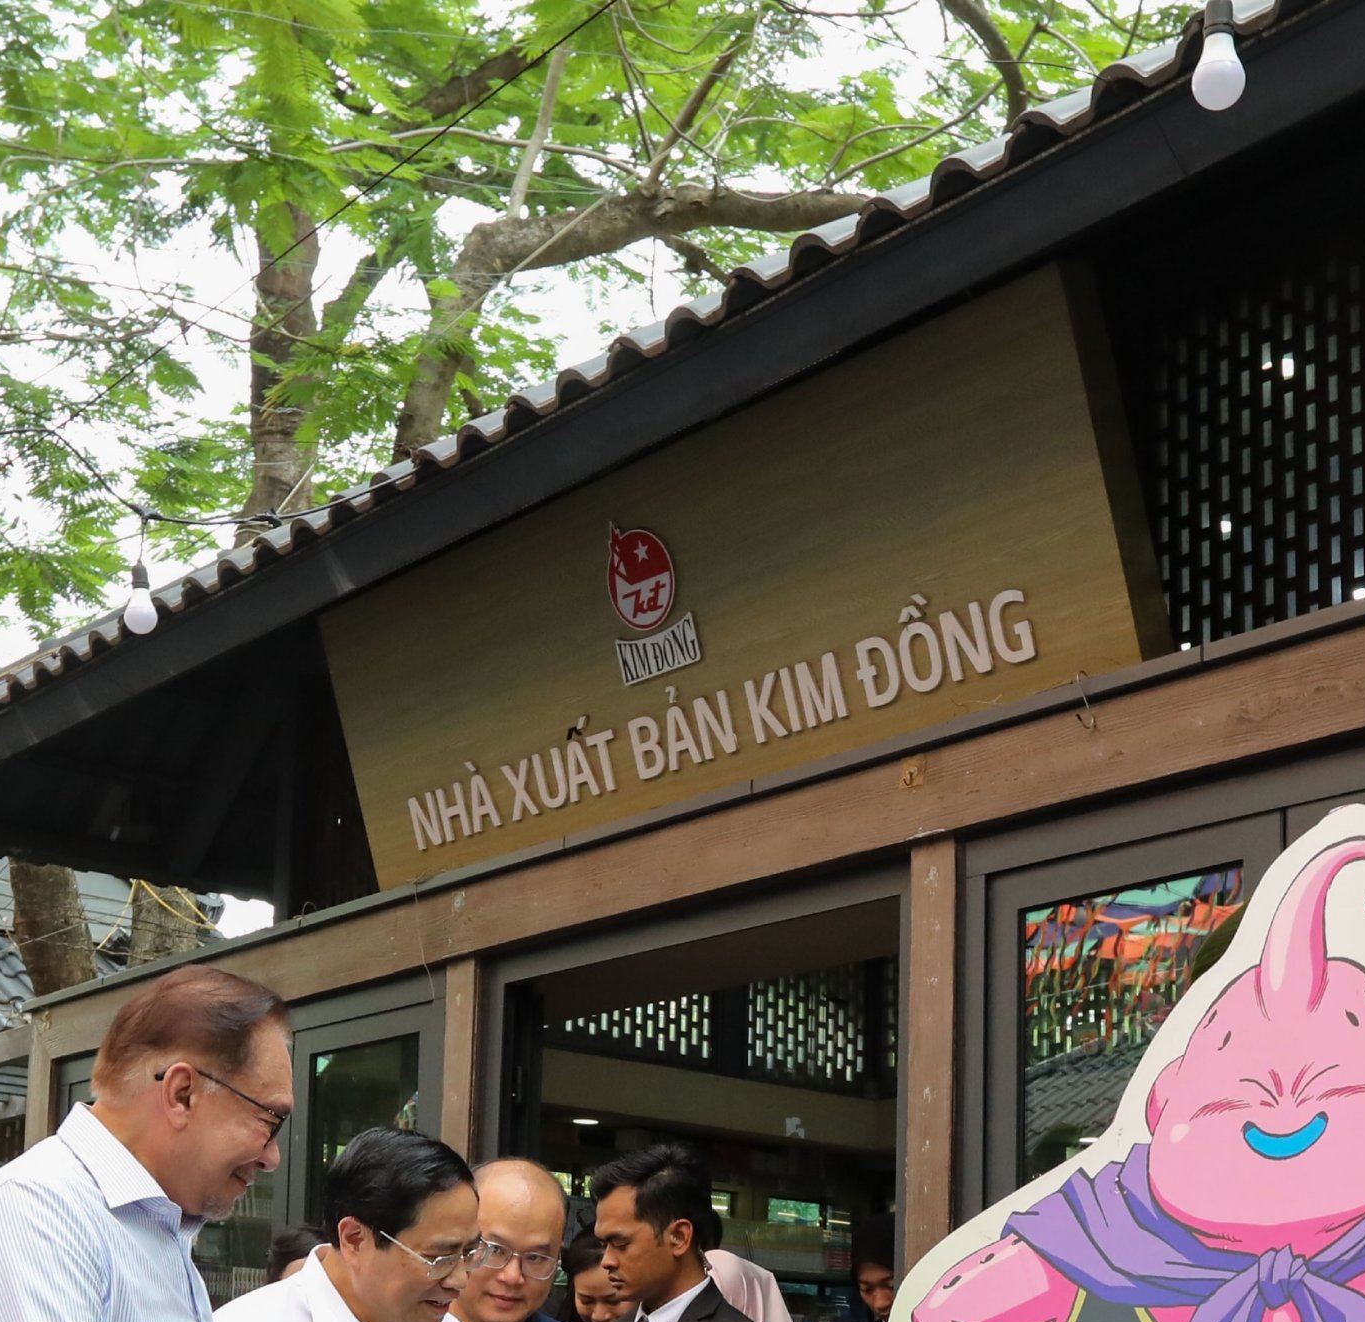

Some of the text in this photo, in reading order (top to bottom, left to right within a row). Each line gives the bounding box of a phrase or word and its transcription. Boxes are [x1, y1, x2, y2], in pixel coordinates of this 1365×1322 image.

[407, 589, 1036, 851] NHÀ XUẤT BẢN KIM ĐỒNG
[618, 642, 653, 684] KIM
